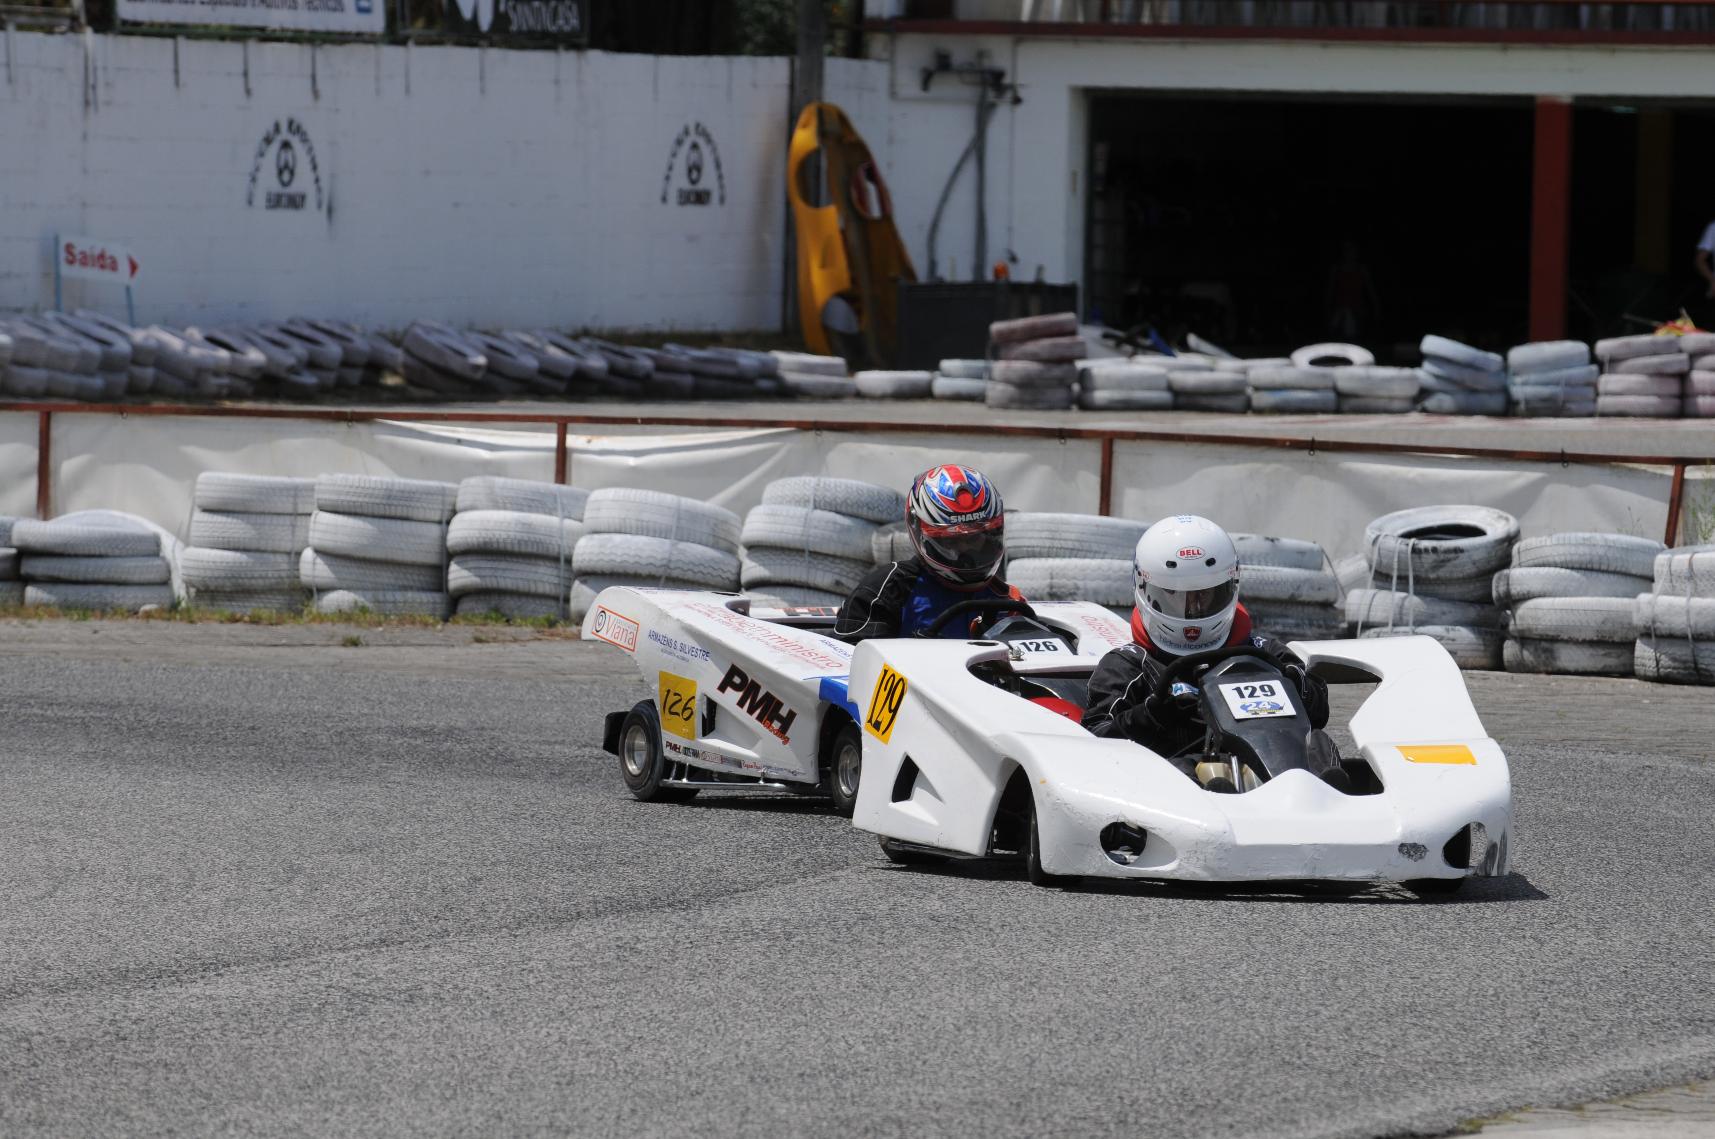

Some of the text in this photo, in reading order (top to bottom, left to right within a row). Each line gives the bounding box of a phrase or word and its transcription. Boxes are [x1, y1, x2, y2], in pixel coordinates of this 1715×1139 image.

[950, 511, 986, 523] SHARK
[1179, 549, 1202, 557] BELL
[1020, 641, 1058, 652] 126
[1232, 684, 1276, 699] 129
[663, 688, 696, 721] 126
[716, 663, 798, 736] PMH
[867, 668, 906, 736] 129
